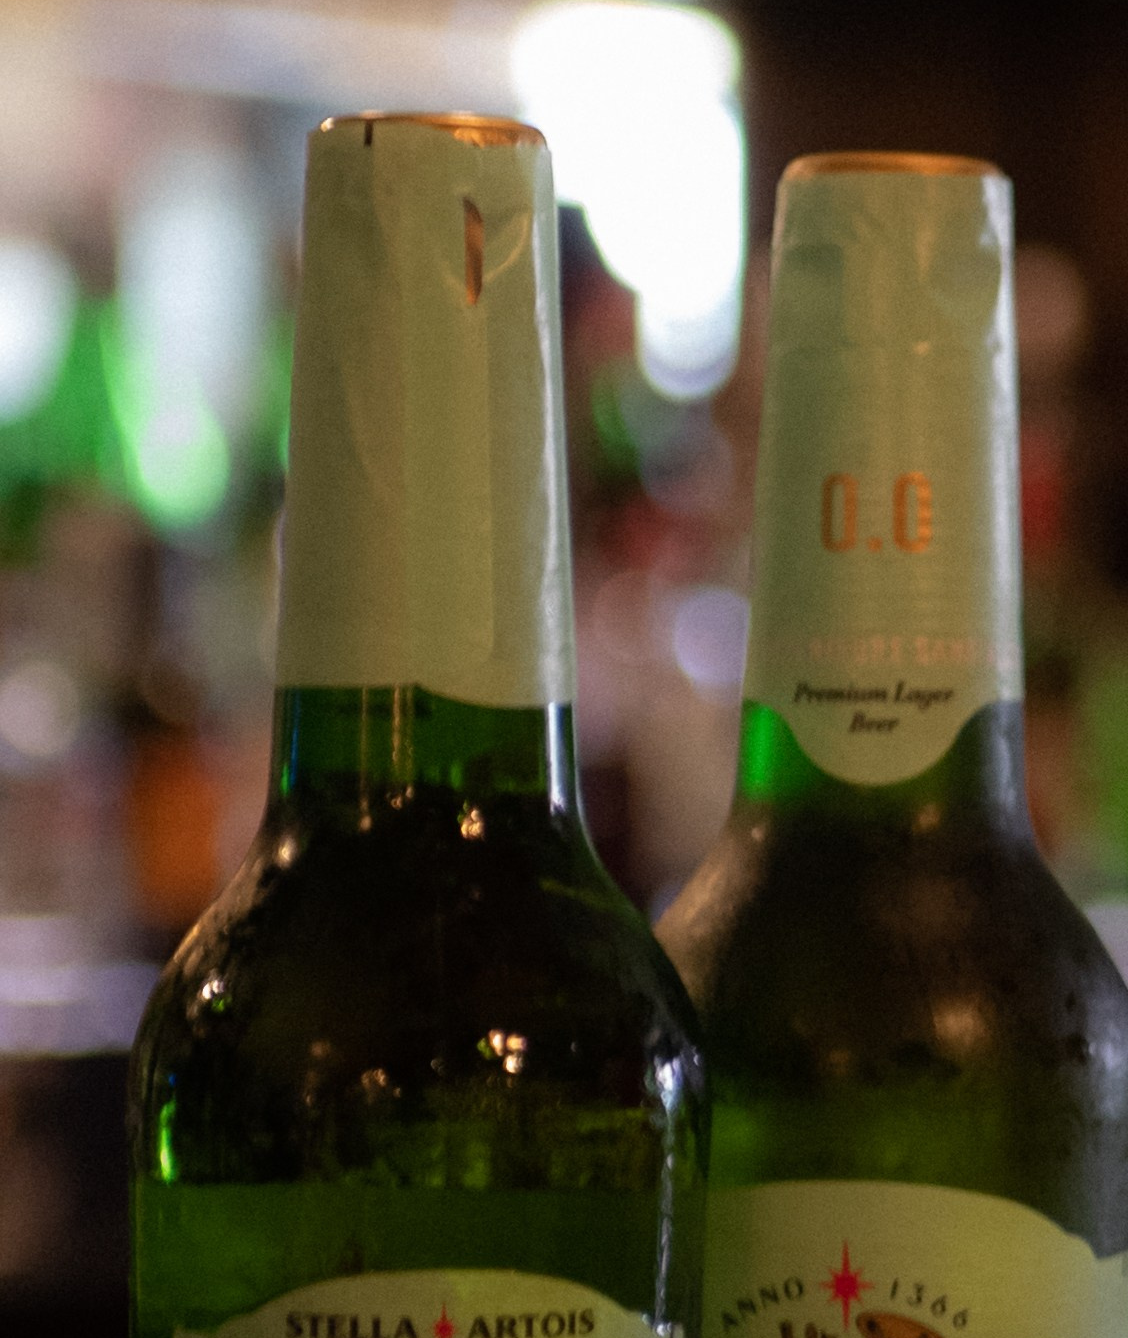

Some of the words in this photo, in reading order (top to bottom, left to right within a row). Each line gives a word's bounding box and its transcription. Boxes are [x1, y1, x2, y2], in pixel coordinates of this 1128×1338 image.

[821, 473, 932, 553] 0.0
[793, 680, 887, 703] Premium
[895, 680, 953, 710] Lager
[849, 712, 899, 734] Beer
[721, 1276, 805, 1334] ANNO
[889, 1277, 970, 1330] 1366
